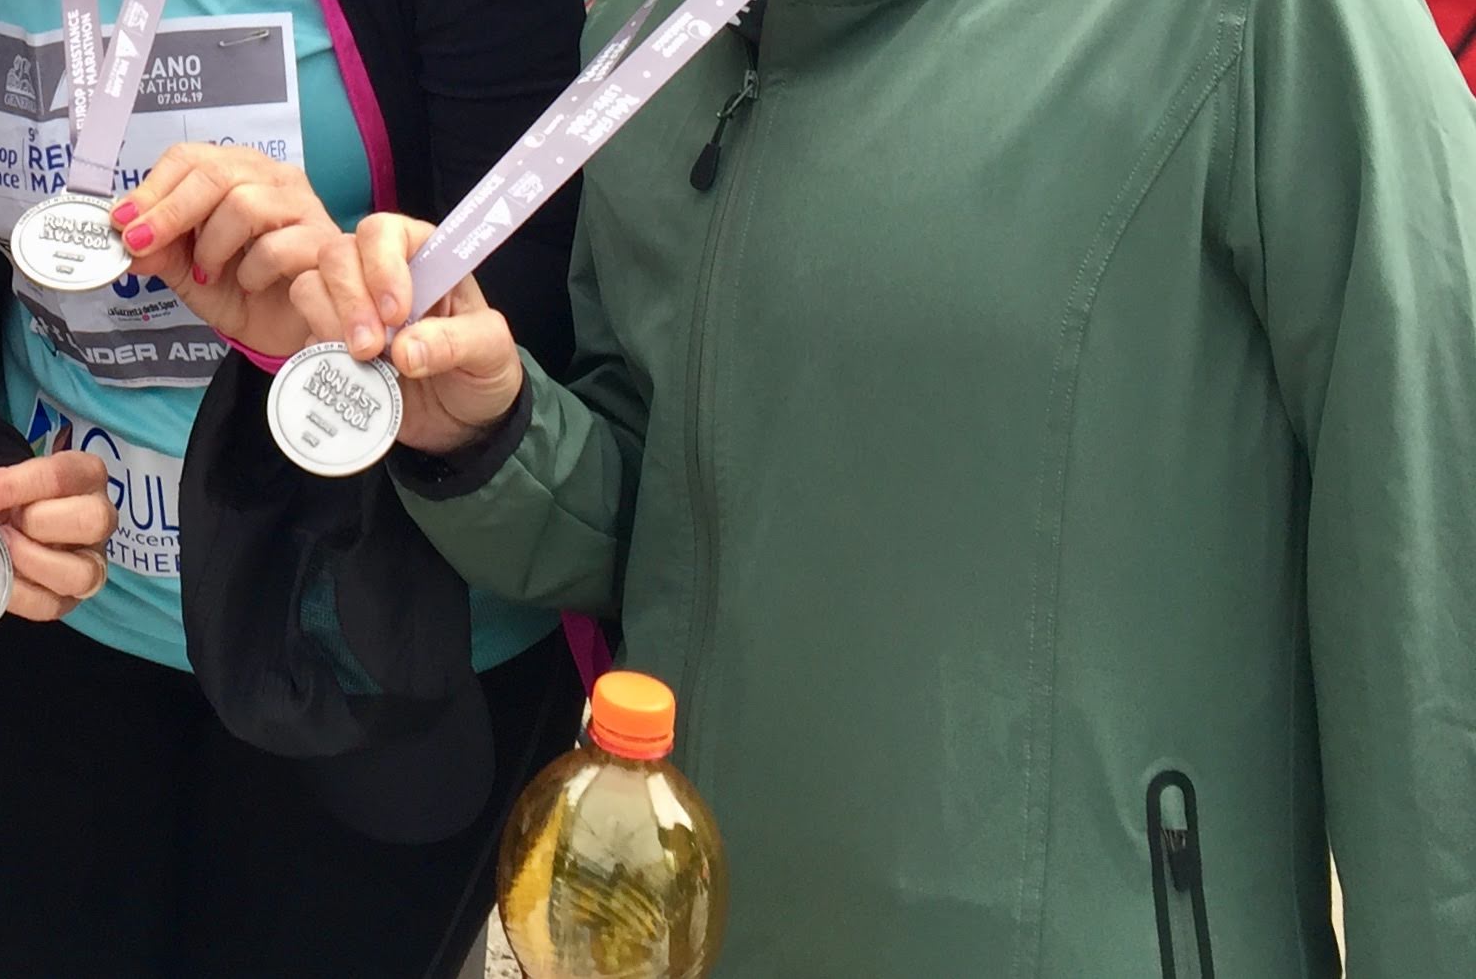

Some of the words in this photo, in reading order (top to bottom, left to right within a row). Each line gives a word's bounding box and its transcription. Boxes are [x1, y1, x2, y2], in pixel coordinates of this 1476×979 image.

[68, 9, 84, 85] ASSISTANCE
[81, 12, 98, 85] MARATHON
[157, 92, 203, 105] 07.04.19
[44, 214, 76, 233] RUN
[77, 221, 111, 238] FAST
[303, 377, 337, 406] LIVE
[335, 402, 371, 432] COOL
[315, 359, 349, 393] RUN
[345, 384, 381, 415] FAST
